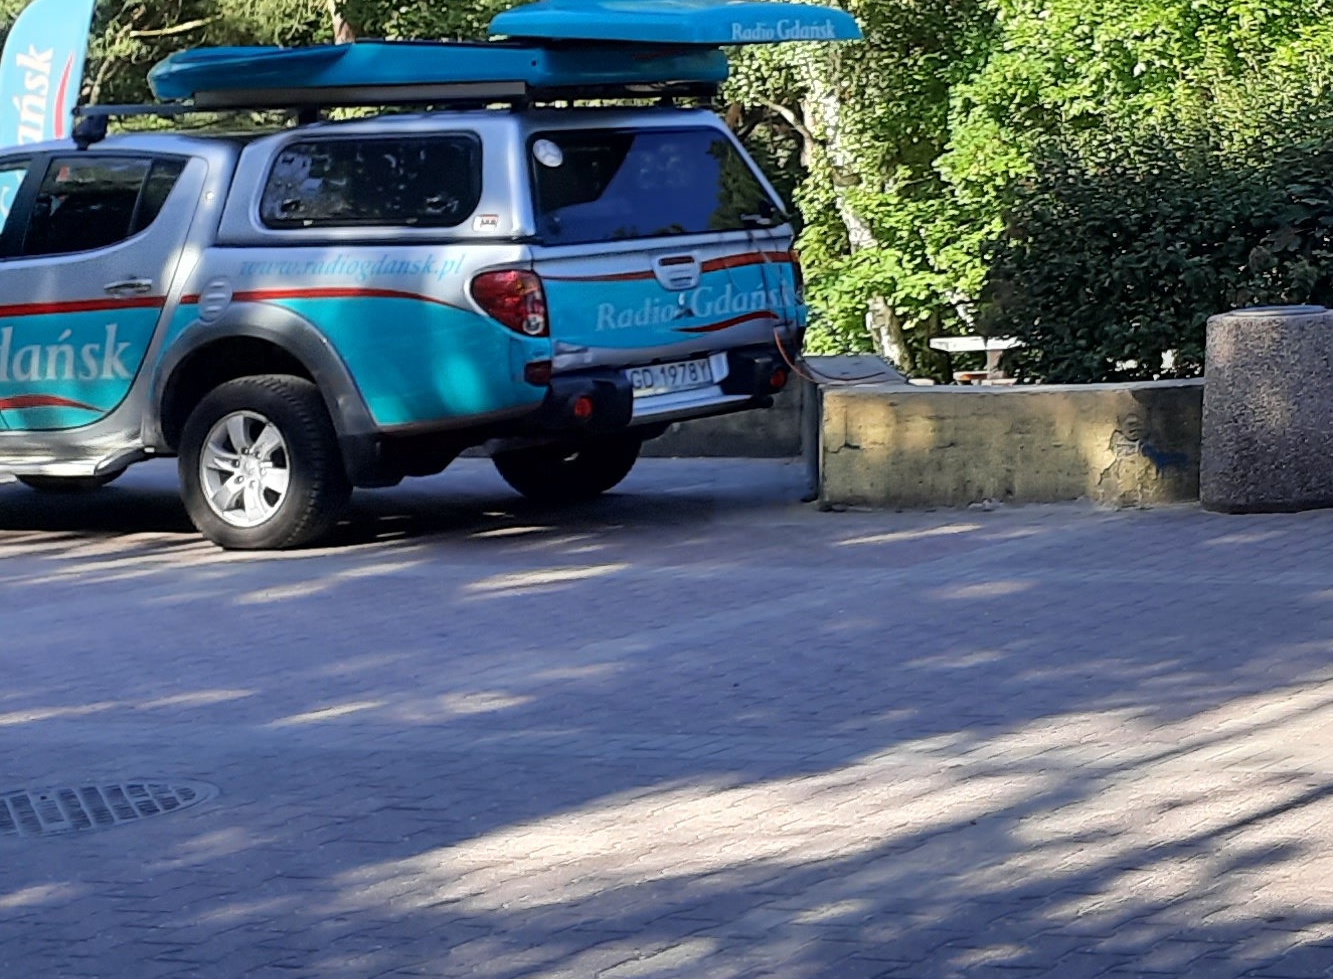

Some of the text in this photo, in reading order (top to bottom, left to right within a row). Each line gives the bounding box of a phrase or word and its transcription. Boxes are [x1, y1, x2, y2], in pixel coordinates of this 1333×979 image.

[731, 18, 836, 40] Radio Gdańsk
[239, 252, 468, 282] www.radiogdansk.pl
[595, 297, 679, 332] Radio
[630, 370, 654, 389] GD
